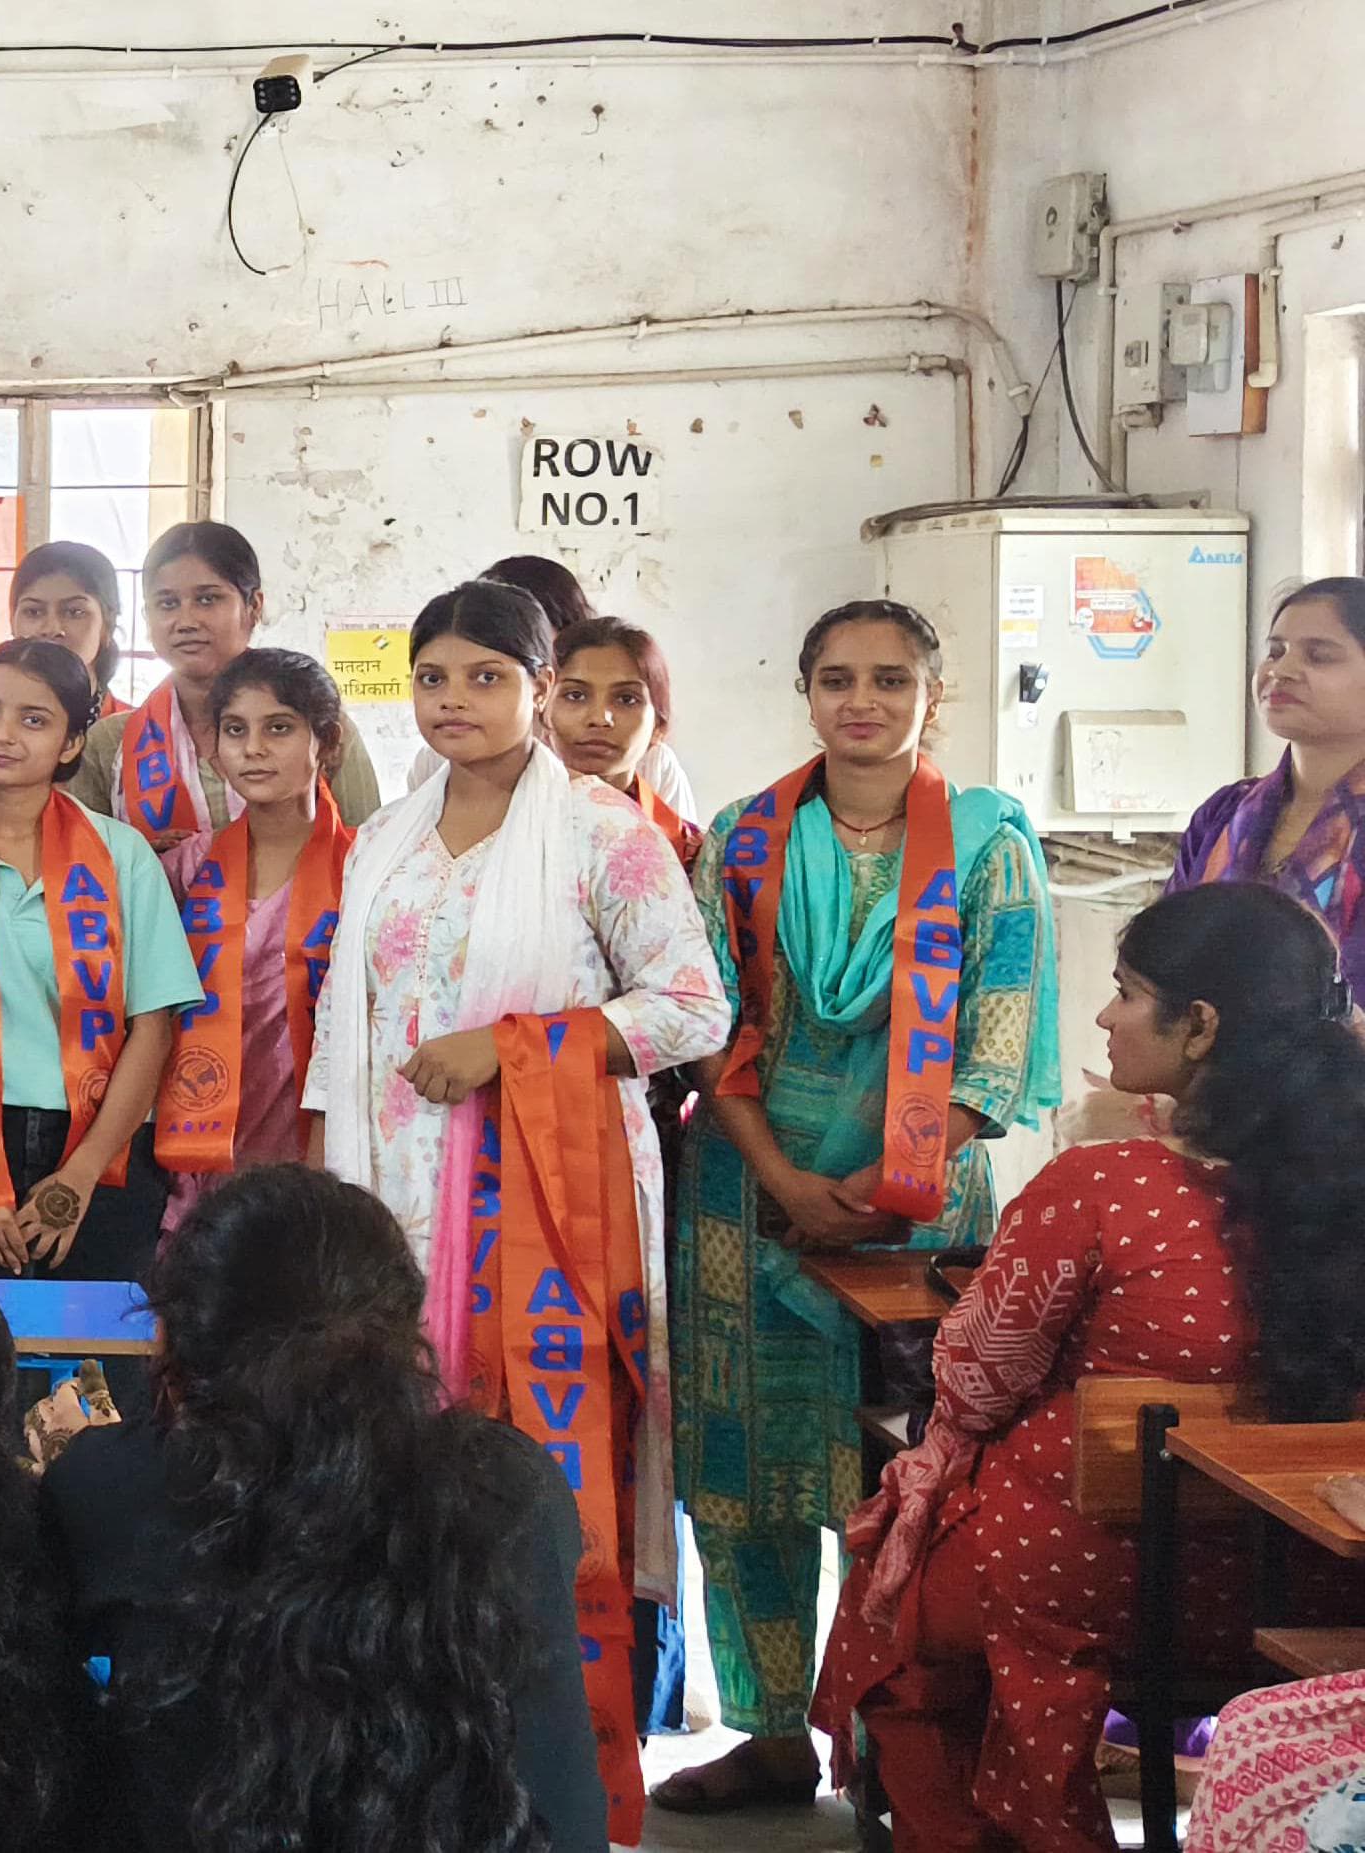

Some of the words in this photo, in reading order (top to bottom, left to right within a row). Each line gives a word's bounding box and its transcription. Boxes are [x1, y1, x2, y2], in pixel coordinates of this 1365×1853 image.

[318, 278, 416, 330] HALL
[532, 438, 653, 478] ROW
[541, 492, 638, 526] NO.1
[333, 660, 381, 675] मतदान
[60, 862, 116, 1052] ABVP
[907, 869, 963, 1076] ABVP
